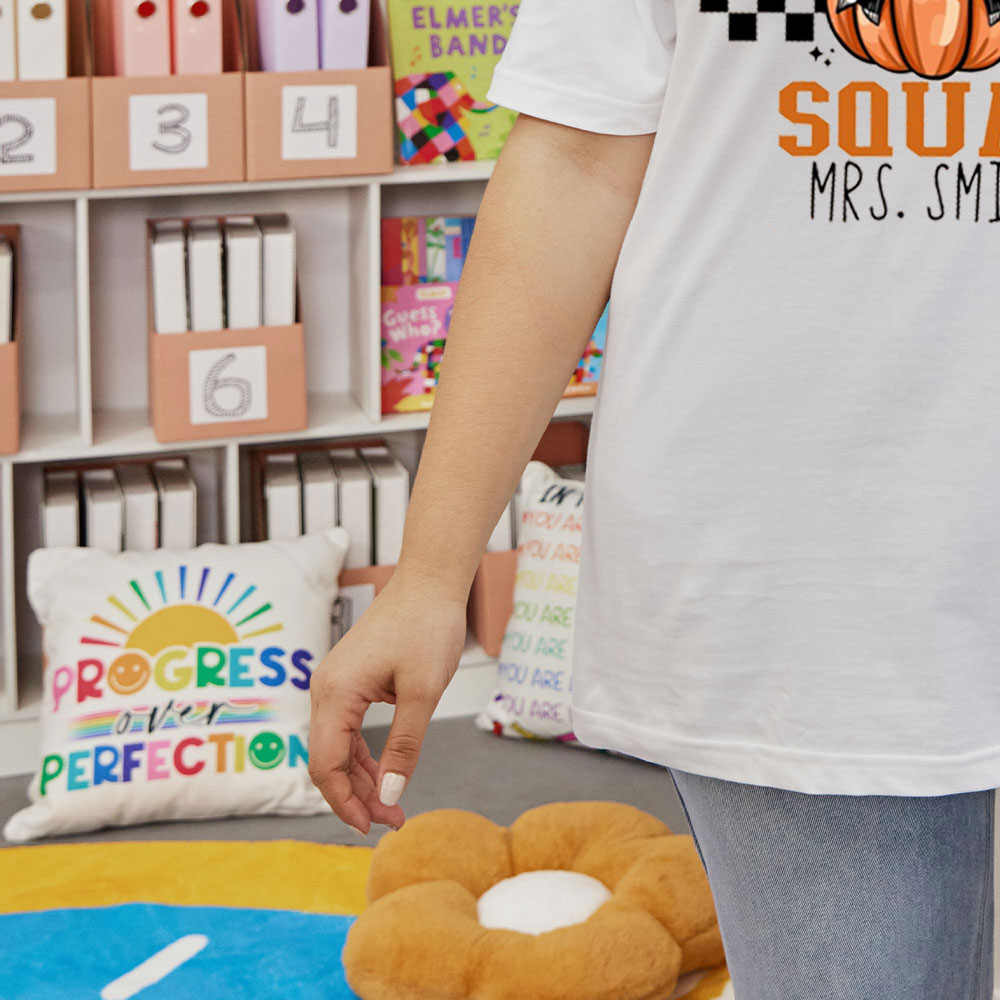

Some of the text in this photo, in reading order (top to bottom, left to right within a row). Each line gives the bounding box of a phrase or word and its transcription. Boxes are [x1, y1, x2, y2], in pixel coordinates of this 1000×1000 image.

[430, 34, 508, 58] BAND
[152, 103, 191, 154] 3
[291, 96, 339, 147] 4
[0, 113, 34, 164] 2
[810, 161, 905, 222] MRS.
[383, 306, 438, 327] Guess
[388, 318, 442, 342] Who?
[204, 353, 252, 418] 6
[551, 543, 581, 564] AR
[516, 570, 549, 591] OU
[512, 602, 538, 622] OU
[53, 646, 314, 713] PROGRESS
[530, 668, 564, 691] ARE
[116, 699, 245, 735] over
